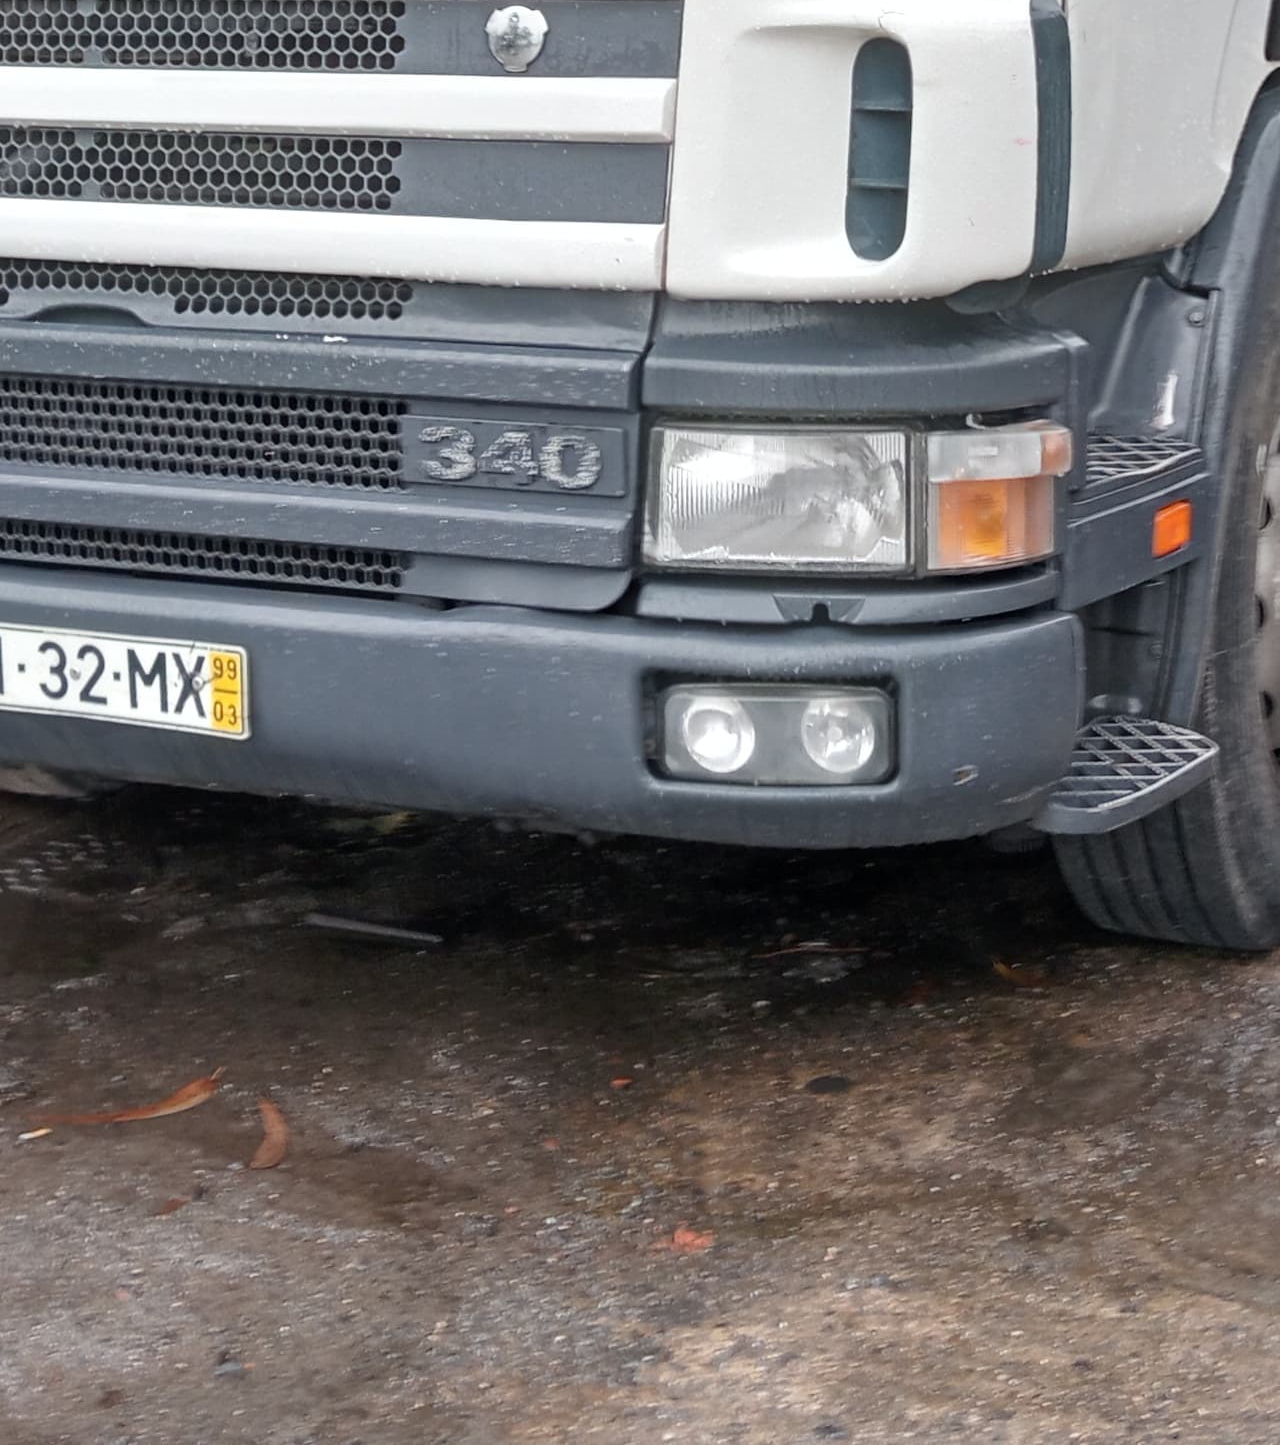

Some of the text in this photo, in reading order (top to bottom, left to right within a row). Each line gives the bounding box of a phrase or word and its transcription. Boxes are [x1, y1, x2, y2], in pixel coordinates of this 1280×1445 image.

[419, 426, 602, 490] 340
[212, 656, 238, 682] 99
[212, 699, 238, 727] 03
